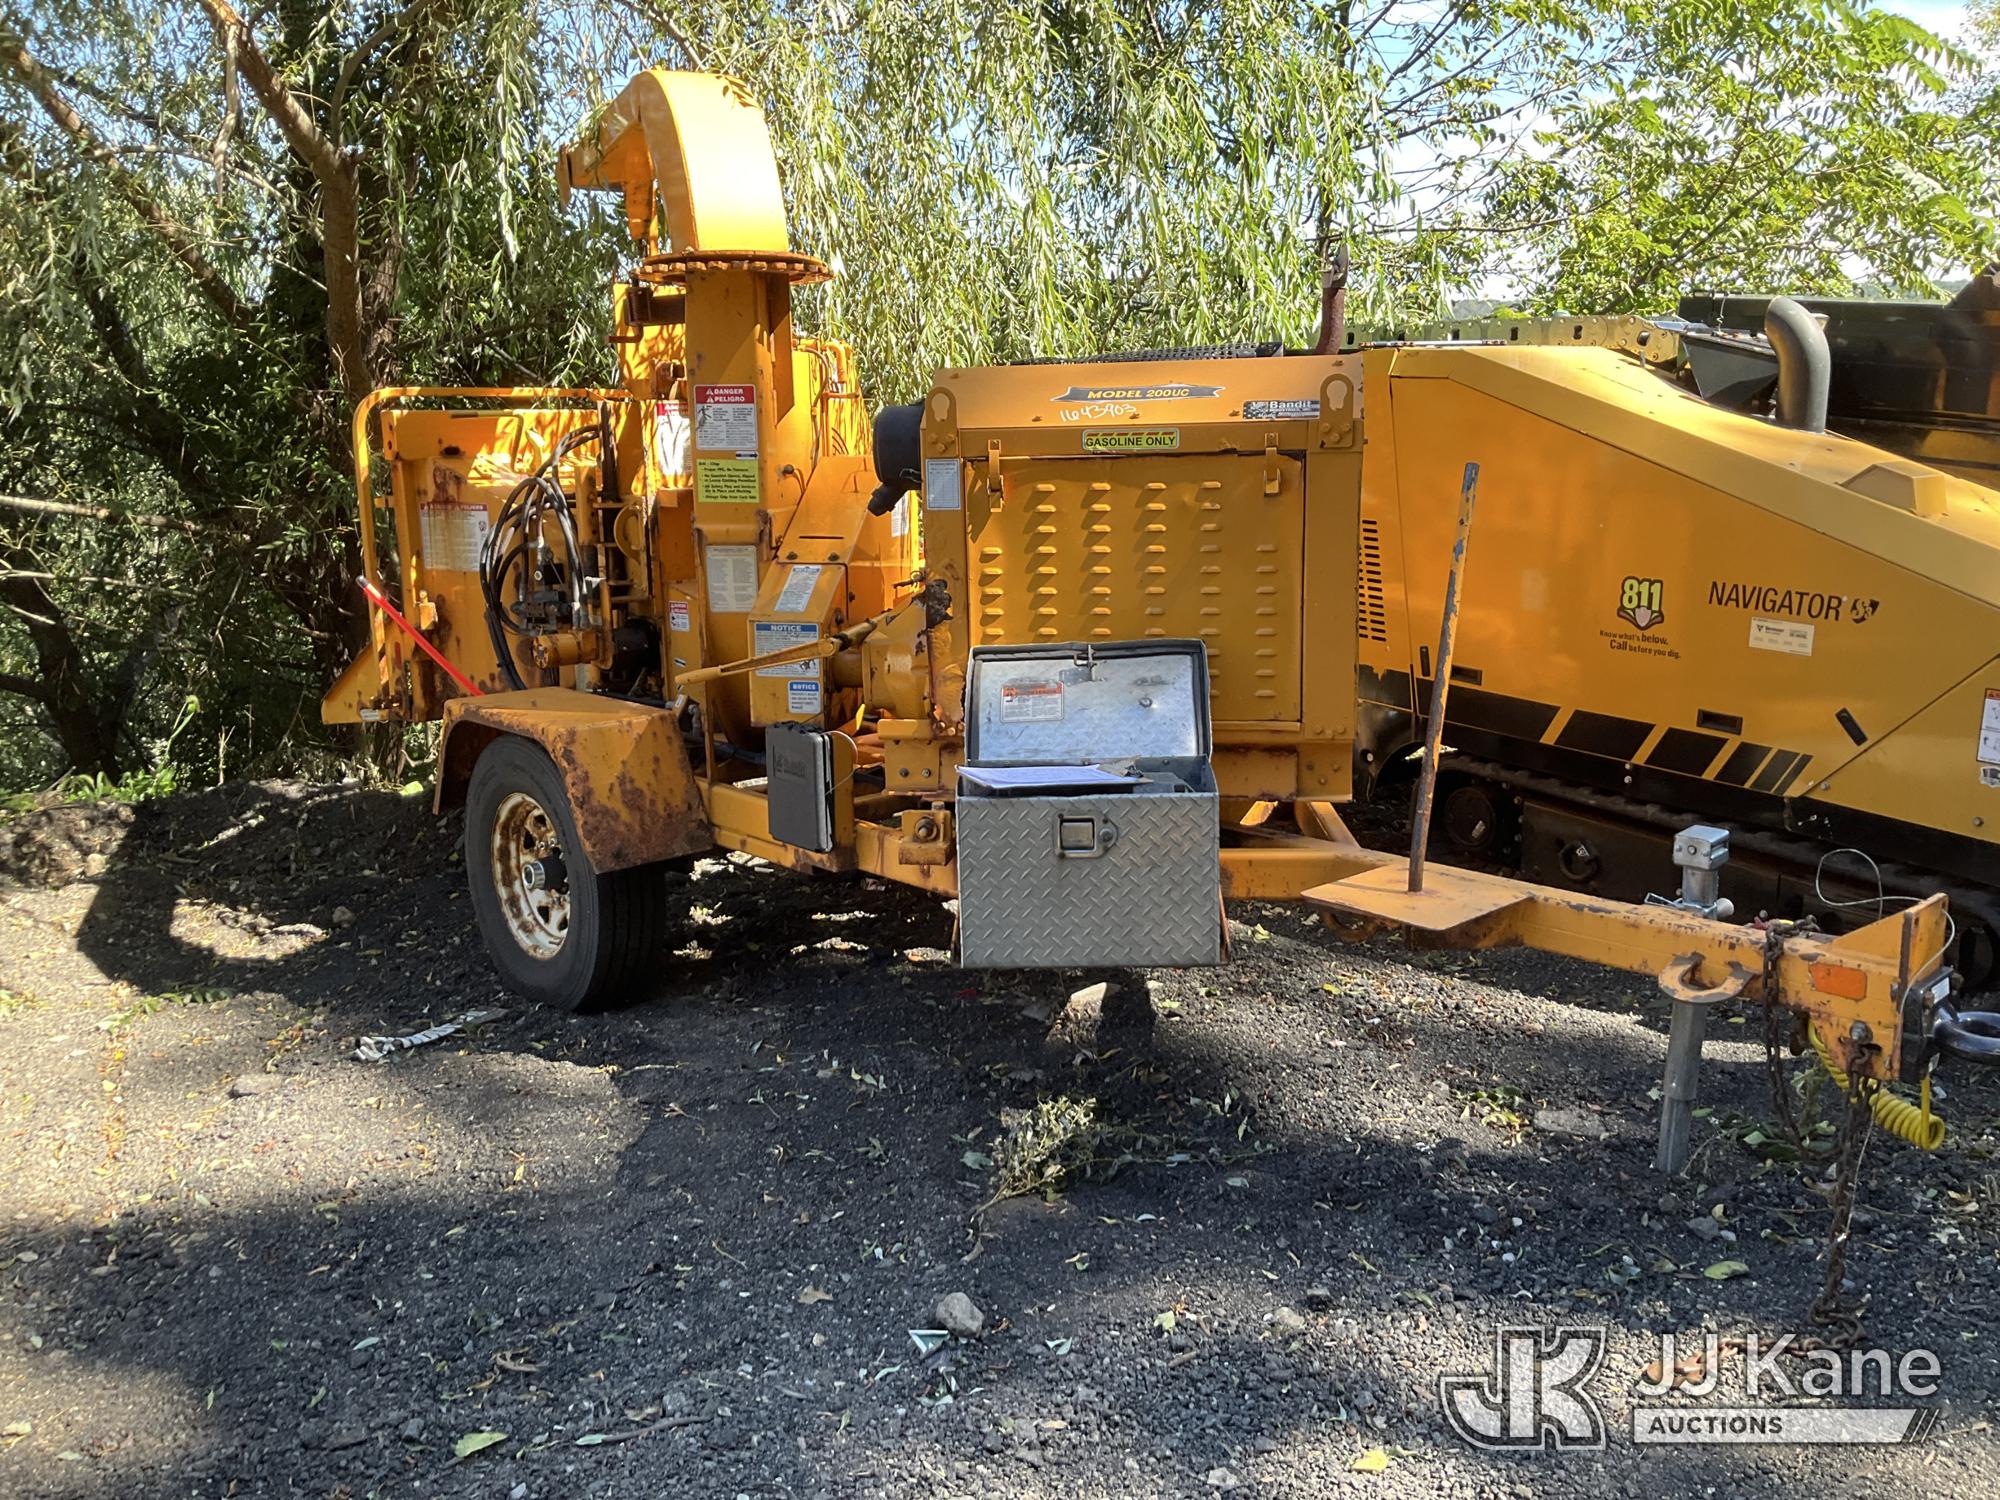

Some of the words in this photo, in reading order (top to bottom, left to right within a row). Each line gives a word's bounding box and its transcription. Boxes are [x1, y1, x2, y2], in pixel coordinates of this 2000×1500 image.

[1087, 389, 1143, 399] MODEL
[1145, 388, 1190, 398] 200UC
[1269, 400, 1312, 410] Bandit
[1085, 436, 1144, 447] GASOLINE
[1145, 435, 1176, 446] ONLY
[1622, 578, 1663, 611] 811
[1708, 580, 1843, 621] NAVIGATOR
[1599, 630, 1617, 638] Know
[1618, 632, 1640, 640] what's
[1641, 633, 1669, 645] below.
[1609, 639, 1628, 651] Call
[1628, 643, 1652, 654] before
[1653, 648, 1666, 656] you
[1667, 649, 1681, 659] dig.
